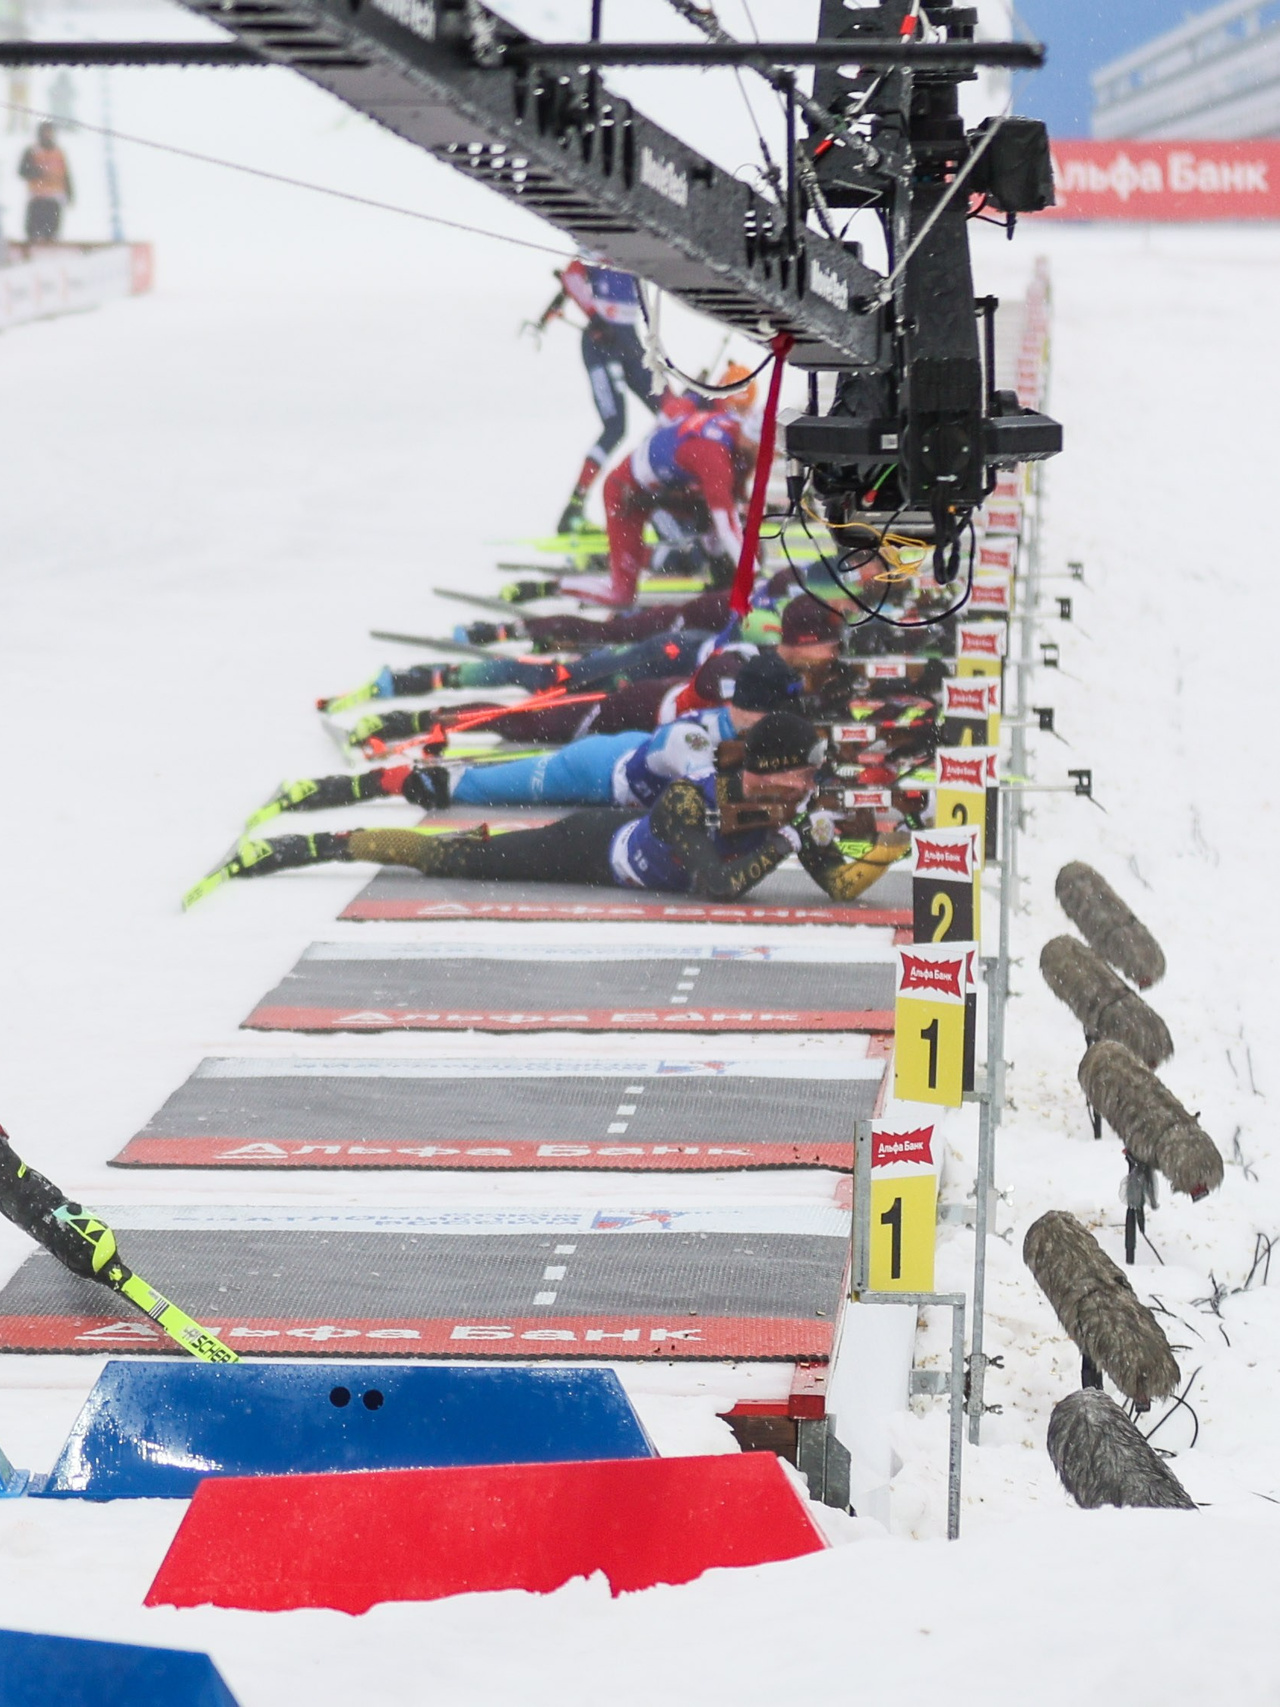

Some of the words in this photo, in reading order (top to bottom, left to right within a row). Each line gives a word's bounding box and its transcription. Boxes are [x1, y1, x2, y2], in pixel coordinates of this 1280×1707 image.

[1168, 152, 1269, 193] Банк
[923, 850, 945, 863] Альфа
[945, 852, 961, 863] Банк
[931, 891, 953, 943] 2
[910, 966, 934, 981] Альфа
[934, 969, 953, 982] Банк
[332, 1011, 590, 1024] Альфа
[610, 1012, 801, 1023] Банк
[921, 1018, 939, 1090] 1
[213, 1143, 514, 1159] Альфа
[536, 1144, 756, 1158] Банк
[878, 1141, 904, 1158] Альфа
[904, 1140, 924, 1151] Банк
[880, 1197, 902, 1280] 1
[449, 1325, 707, 1342] Банк
